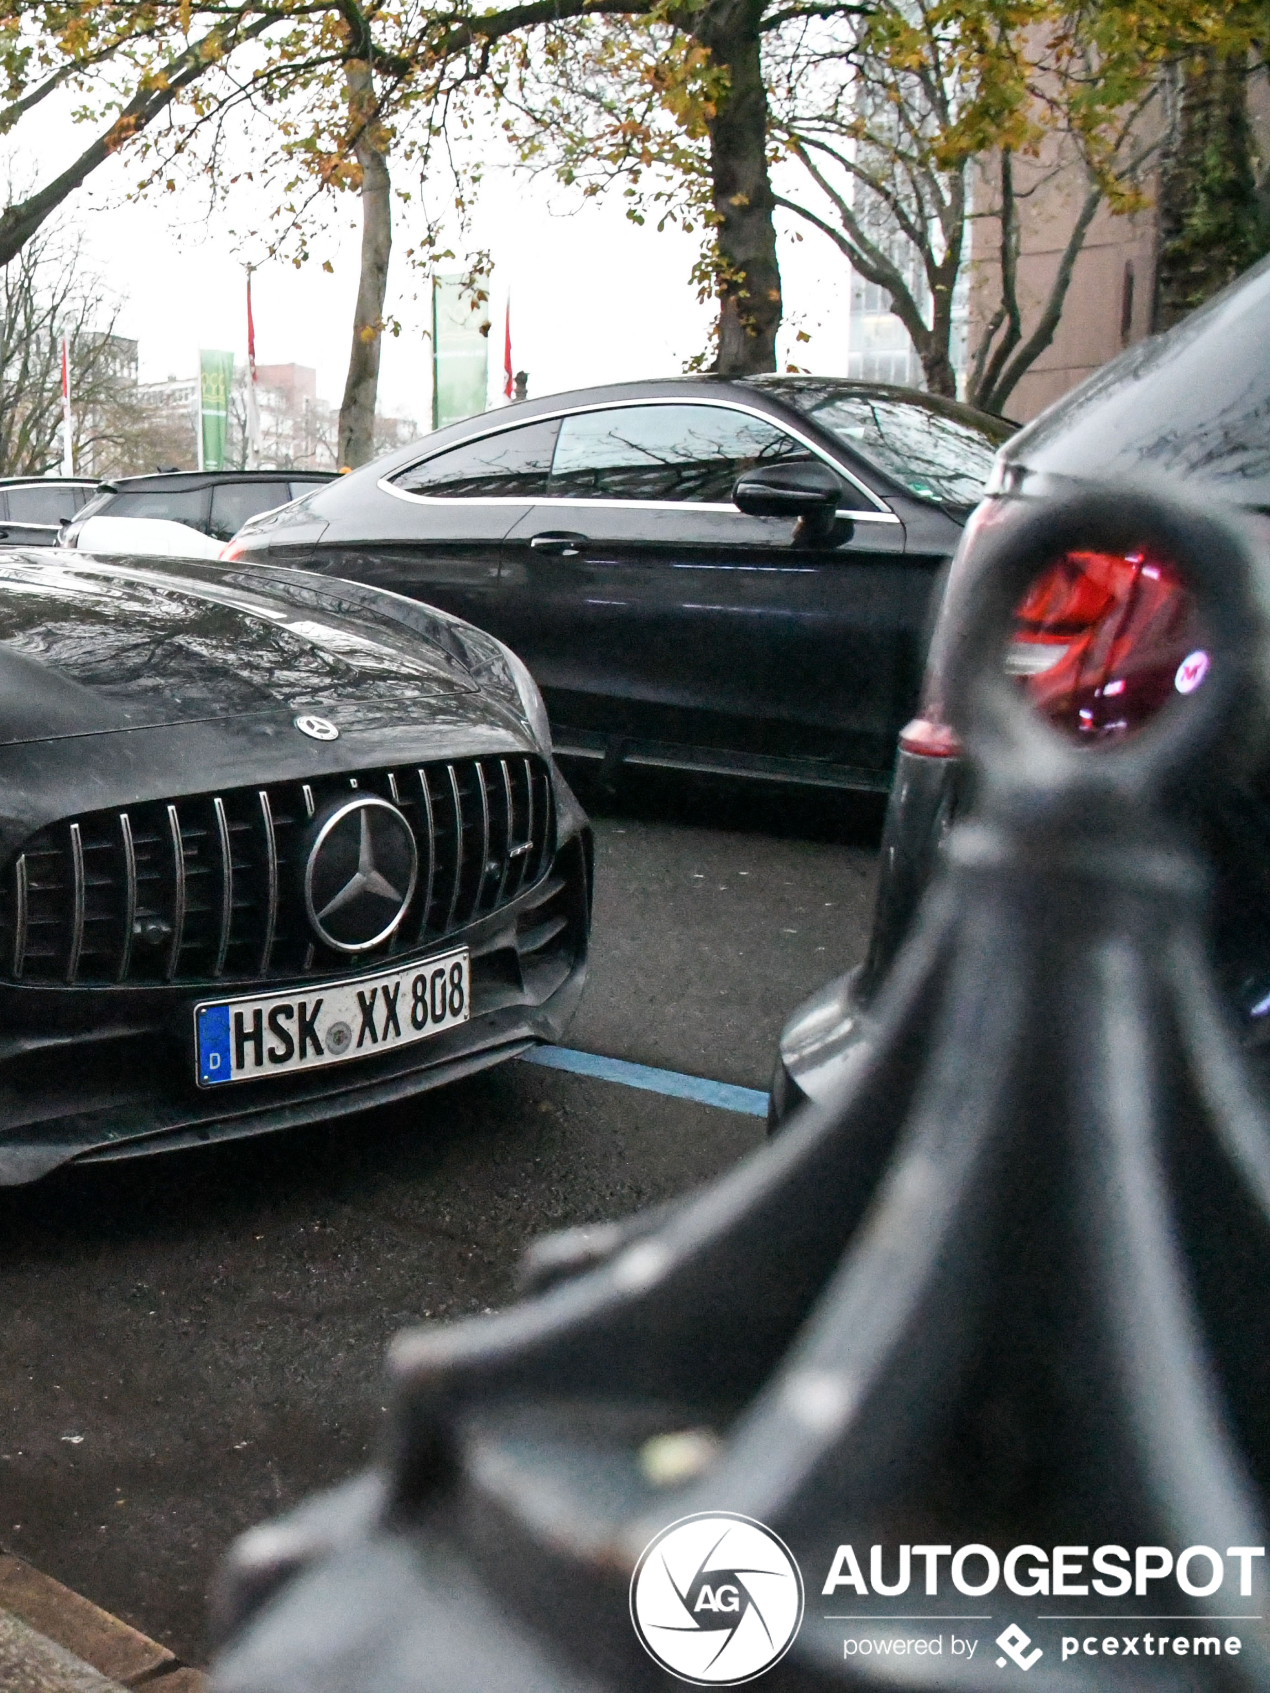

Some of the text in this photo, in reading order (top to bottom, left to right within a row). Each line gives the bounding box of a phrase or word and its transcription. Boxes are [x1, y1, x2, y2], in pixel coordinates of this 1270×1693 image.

[233, 962, 464, 1070] HSK XX 808
[209, 1052, 221, 1070] D
